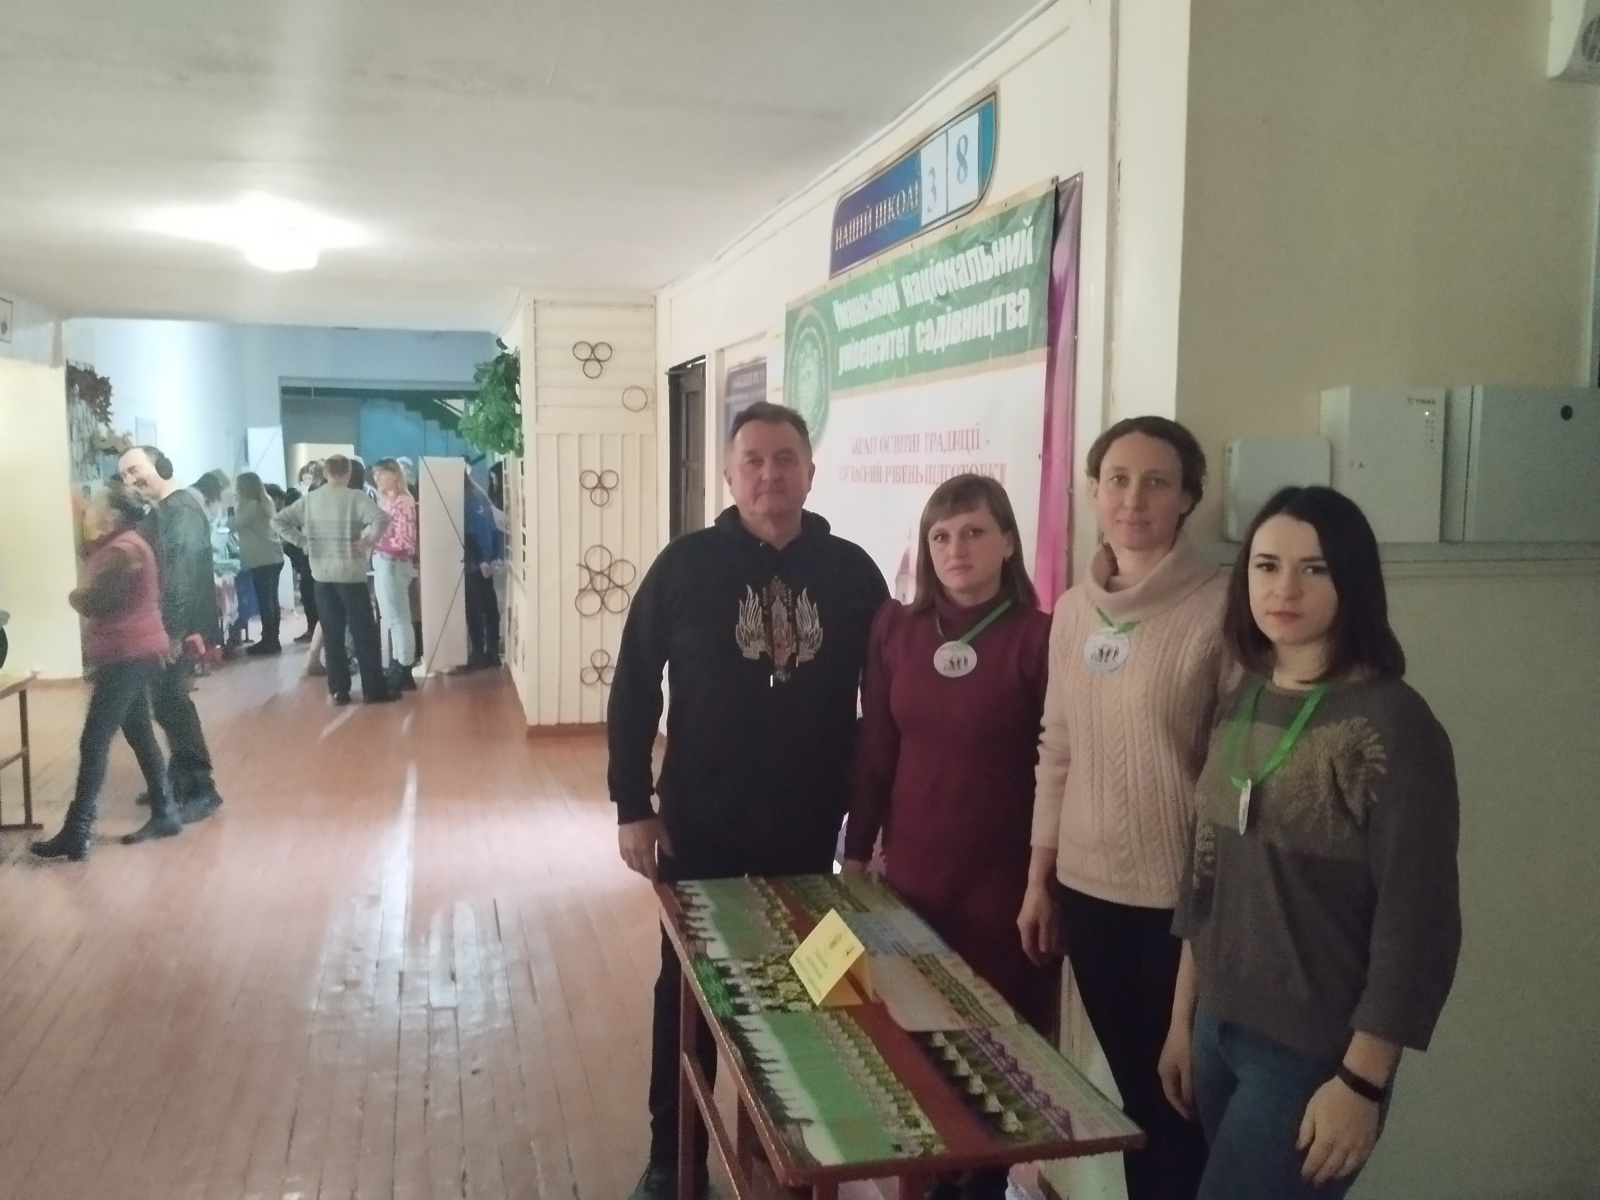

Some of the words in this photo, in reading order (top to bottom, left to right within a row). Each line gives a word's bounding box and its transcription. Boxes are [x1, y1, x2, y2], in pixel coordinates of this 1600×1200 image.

[926, 166, 937, 214] 3
[956, 134, 969, 185] 8
[835, 204, 872, 251] НАШІЙ
[901, 216, 1034, 307] національний
[915, 288, 1030, 354] садівництва
[879, 432, 921, 455] ОСВІТНІ
[924, 423, 981, 455] ТРАДИЦІЇ
[838, 460, 883, 484] СУЧАСНИЙ
[884, 463, 924, 485] РІВЕНЬ
